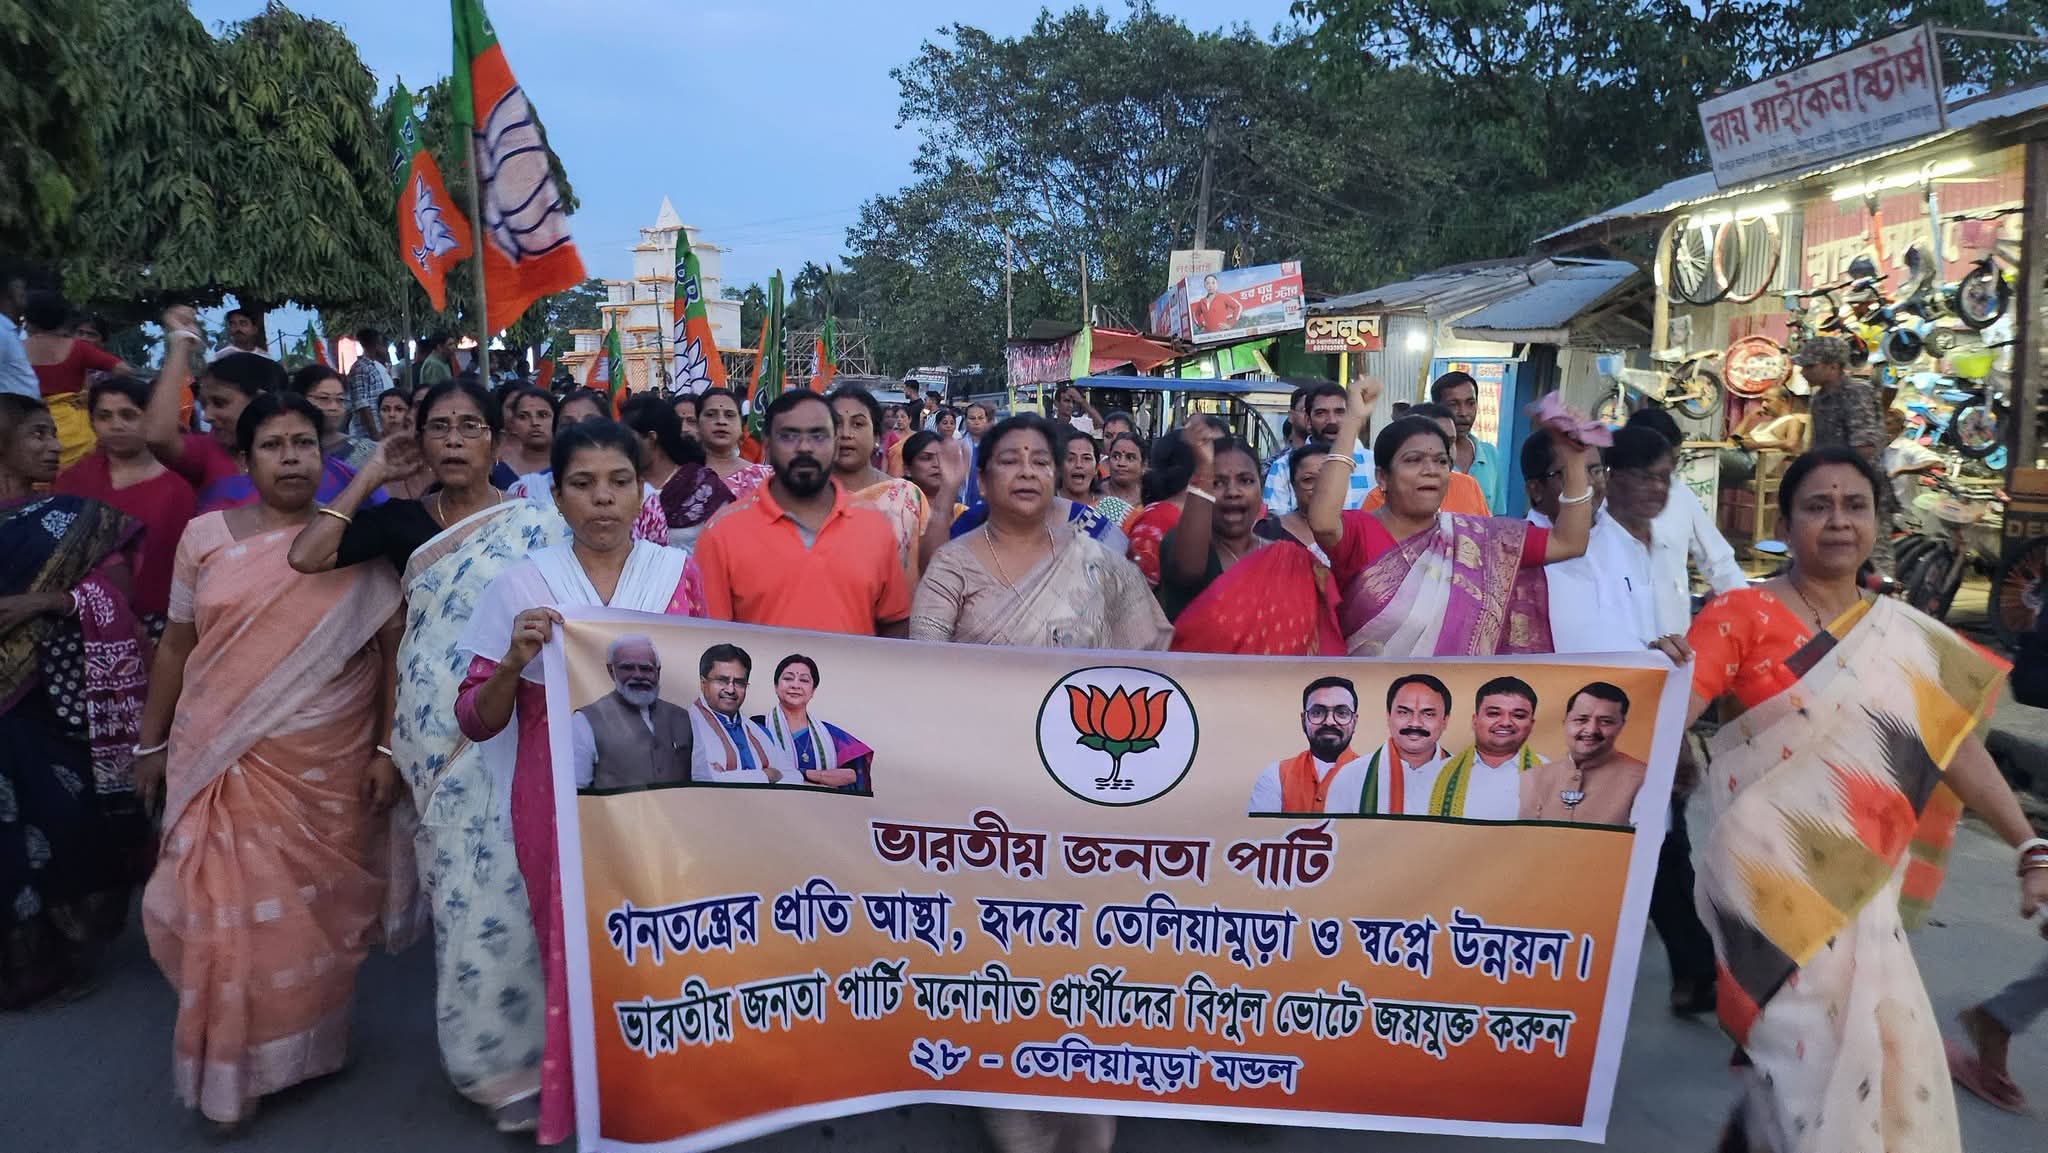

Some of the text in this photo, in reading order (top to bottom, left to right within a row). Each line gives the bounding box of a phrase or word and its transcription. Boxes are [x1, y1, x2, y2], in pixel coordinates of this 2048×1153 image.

[1706, 107, 1750, 150] রায়
[1751, 72, 1851, 134] সাইকেল
[1306, 316, 1380, 348] সেলুন
[2006, 520, 2048, 537] DE
[873, 810, 1334, 886] ভারতীয় জনতা পার্টি
[608, 895, 760, 964] গনতন্ত্রের
[774, 879, 852, 942] প্রতি
[863, 891, 964, 954] আস্থা,
[977, 899, 1084, 952] হৃদয়ে
[1096, 892, 1298, 968] তেলিয়ামুড়া
[1311, 919, 1340, 956] ও
[1352, 915, 1435, 976] স্বপ্নে
[1450, 910, 1570, 980] উন্নয়ন
[617, 960, 1573, 1056] ভারতীয় জনতা পার্টি মনোনীত প্রার্থীদের বিপুল ভোটে জয়যুক্ত করুন
[914, 1041, 969, 1077] ২৮
[1015, 1035, 1200, 1090] তেলিয়ামুড়া
[1210, 1054, 1303, 1092] মন্ডল
